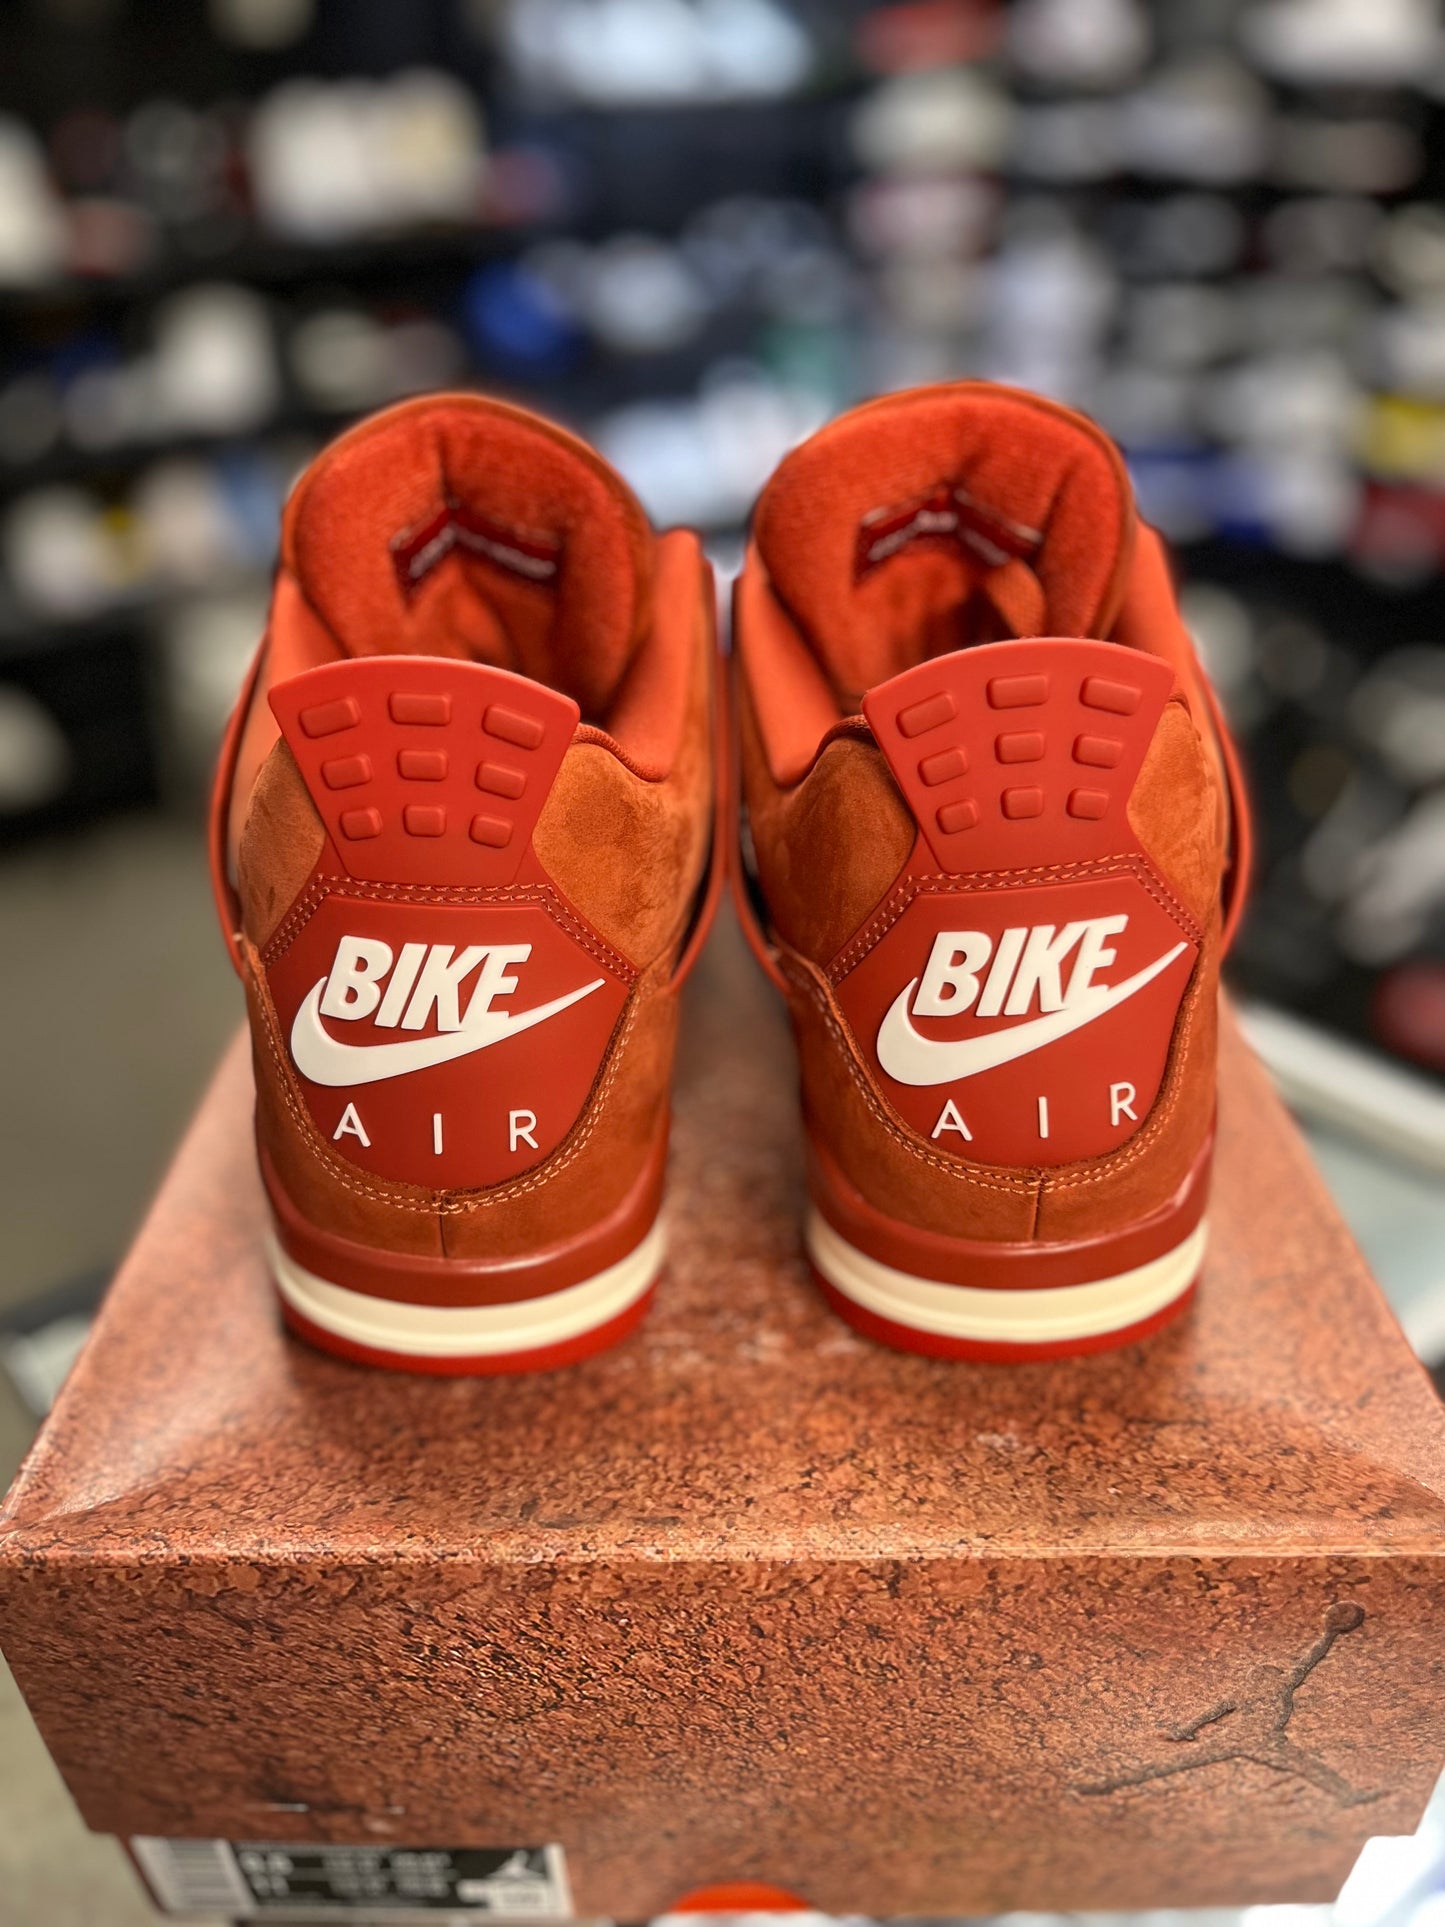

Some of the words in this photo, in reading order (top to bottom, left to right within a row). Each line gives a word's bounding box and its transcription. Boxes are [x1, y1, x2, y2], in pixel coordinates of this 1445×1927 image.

[319, 935, 532, 1032] BIKE
[912, 914, 1129, 1017] BIKE
[333, 1102, 538, 1155] AIR
[931, 1082, 1138, 1141] AIR
